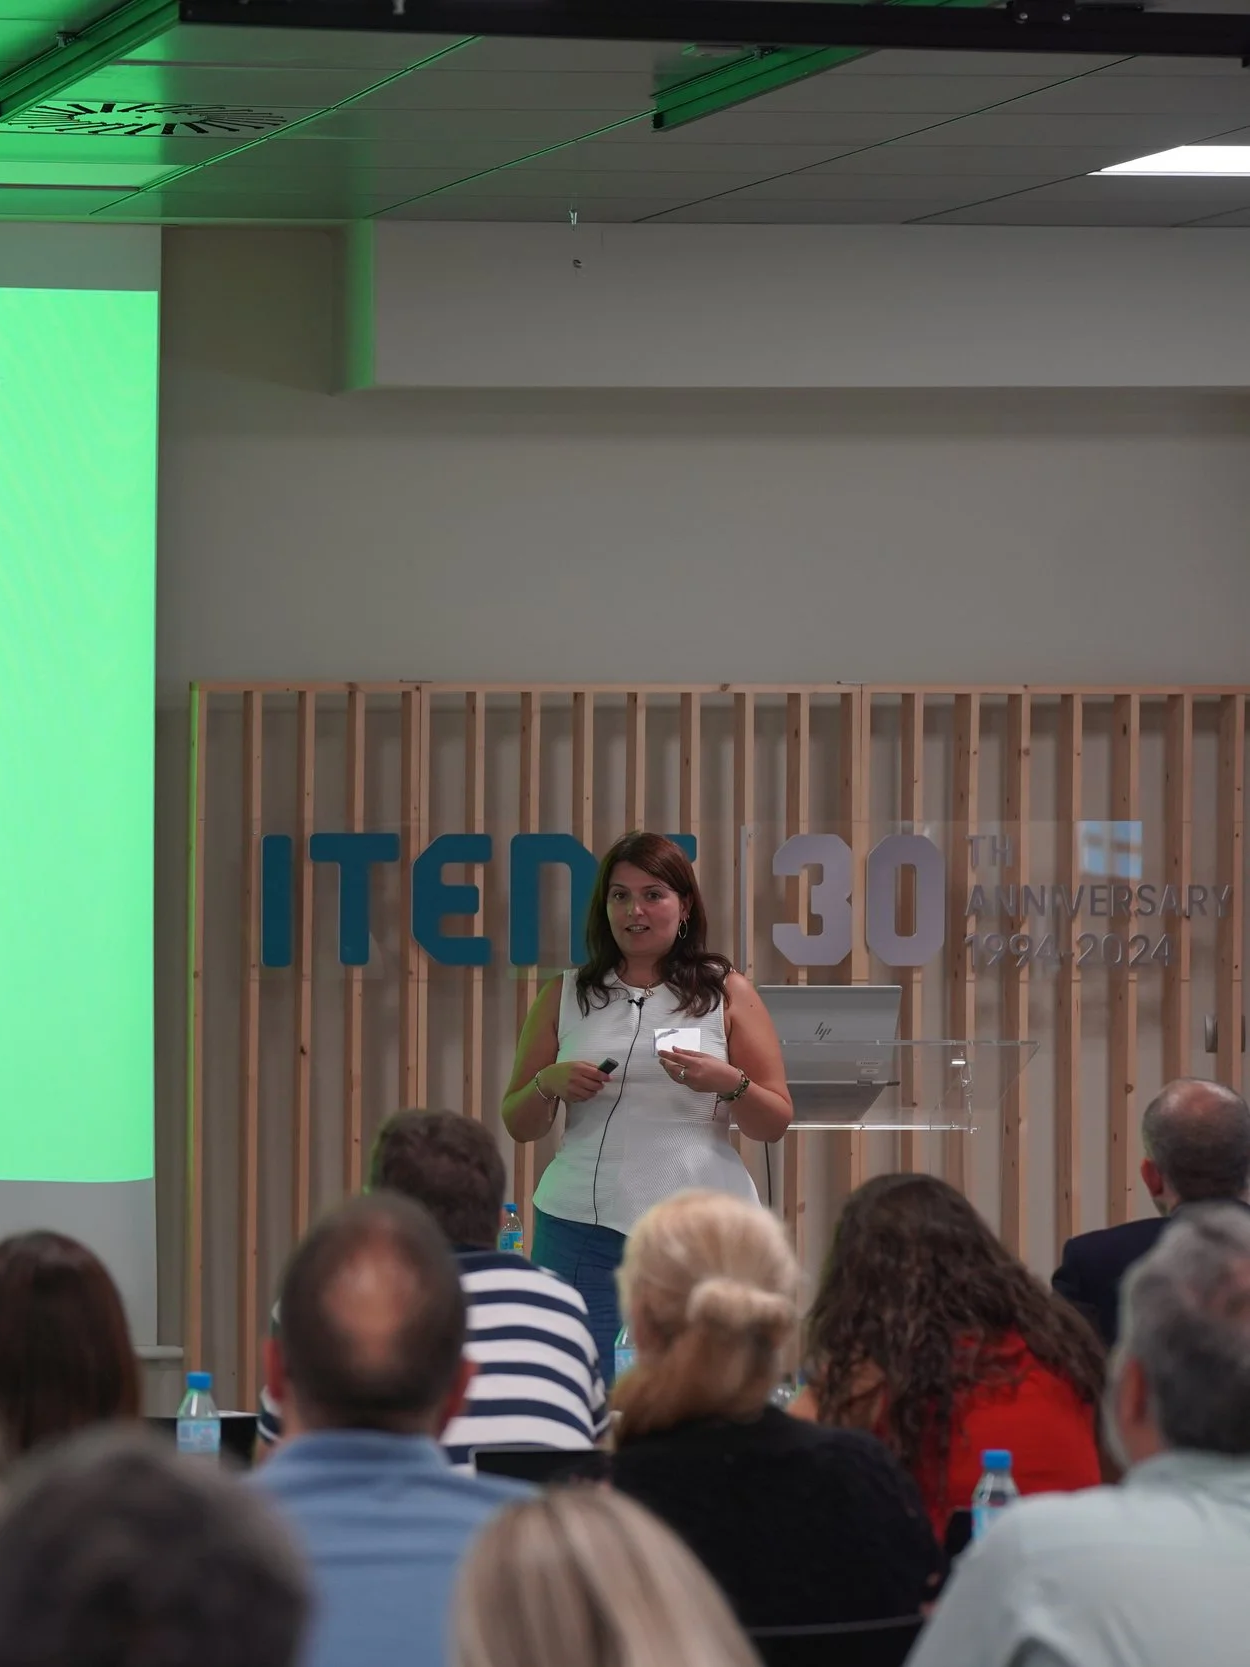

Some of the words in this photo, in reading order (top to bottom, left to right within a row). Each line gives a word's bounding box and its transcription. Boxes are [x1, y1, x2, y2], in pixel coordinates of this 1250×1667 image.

[965, 834, 1014, 869] TH
[261, 832, 698, 968] ITEN
[772, 833, 946, 967] 30
[964, 883, 1236, 918] ANNIVERSARY
